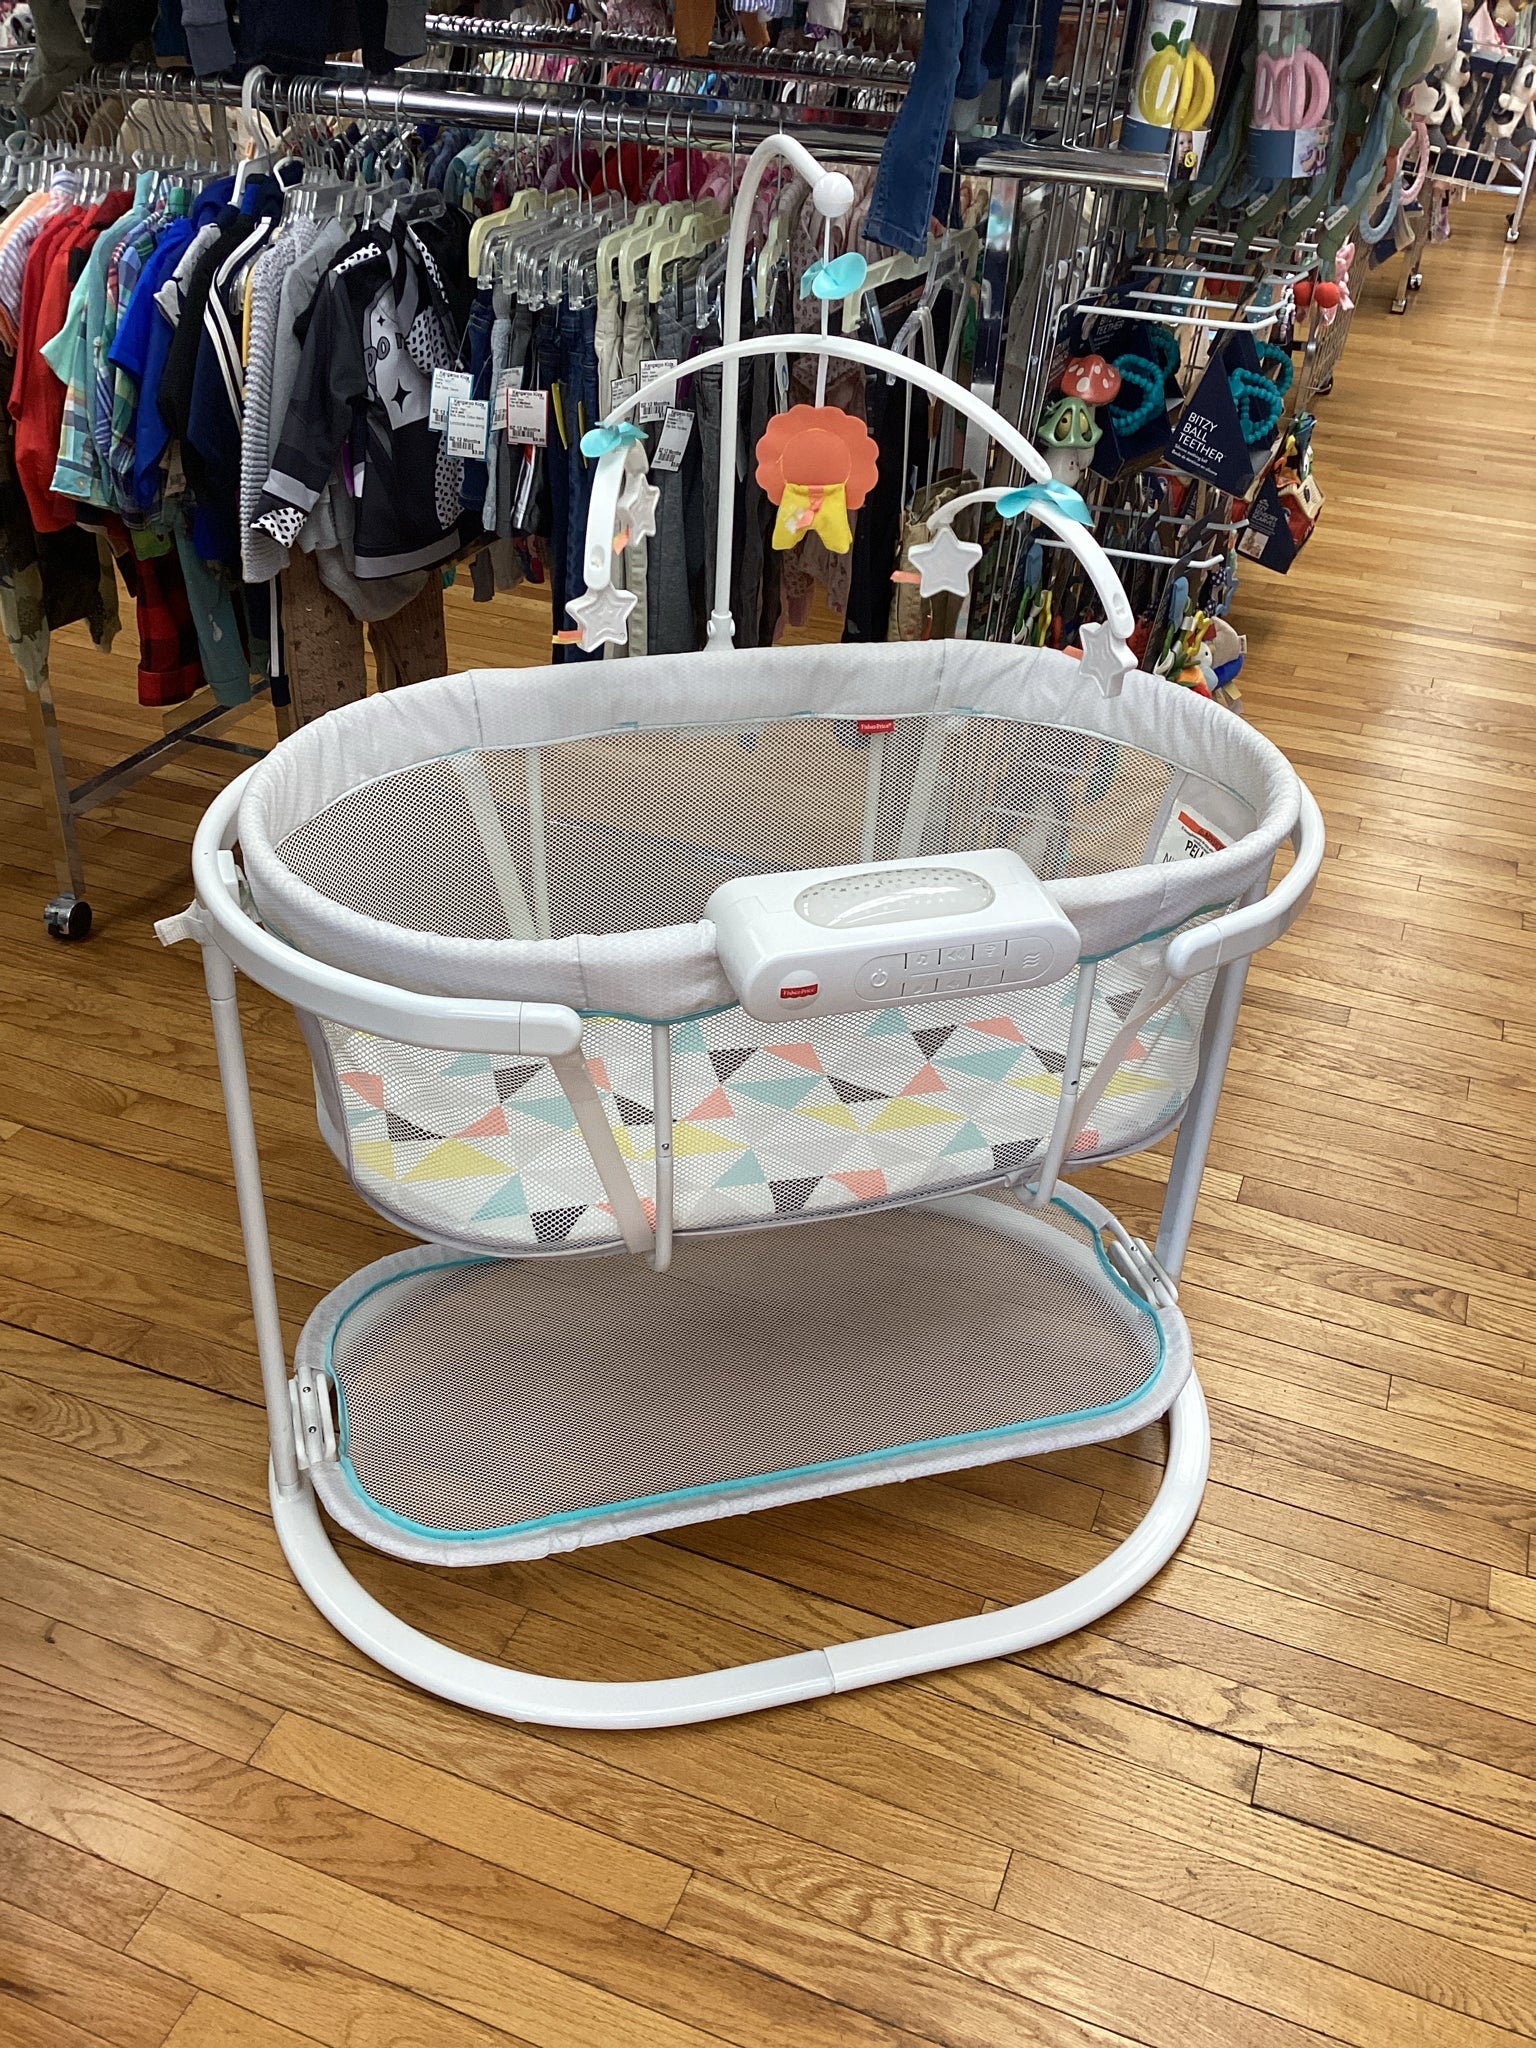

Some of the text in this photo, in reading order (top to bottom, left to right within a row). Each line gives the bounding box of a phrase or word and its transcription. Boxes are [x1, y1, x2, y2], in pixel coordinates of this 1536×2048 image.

[1182, 422, 1207, 443] BALL
[1188, 411, 1218, 433] BITZY
[1178, 431, 1224, 463] TEETHER
[782, 986, 817, 996] Fisher-Price
